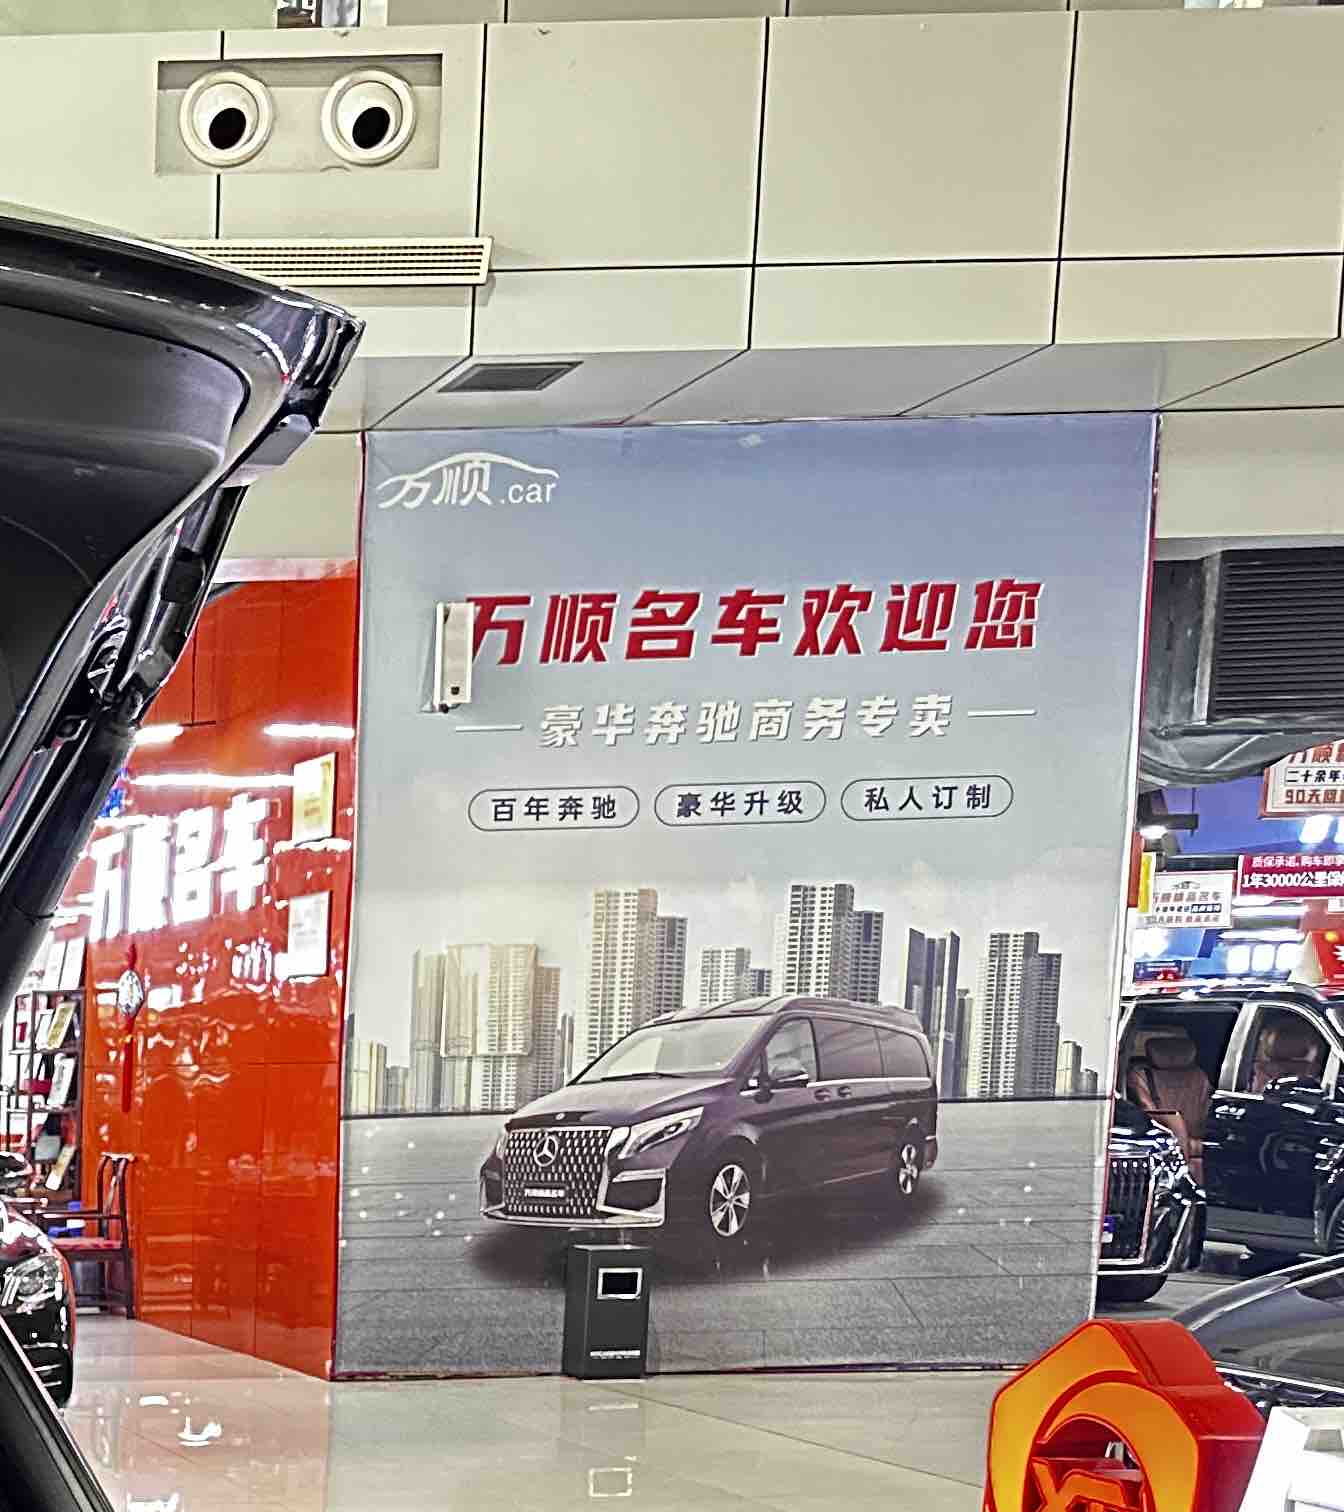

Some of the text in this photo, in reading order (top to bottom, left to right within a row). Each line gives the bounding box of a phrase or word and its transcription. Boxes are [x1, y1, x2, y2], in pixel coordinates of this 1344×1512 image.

[469, 577, 1044, 666] 万顺名车欢迎您
[538, 693, 955, 749] 豪华奔驰商务专卖
[1287, 769, 1344, 783] 二十余年
[491, 784, 992, 823] 百年奔驰 豪华升级 私人订制
[1242, 871, 1344, 888] 1年30000公里保
